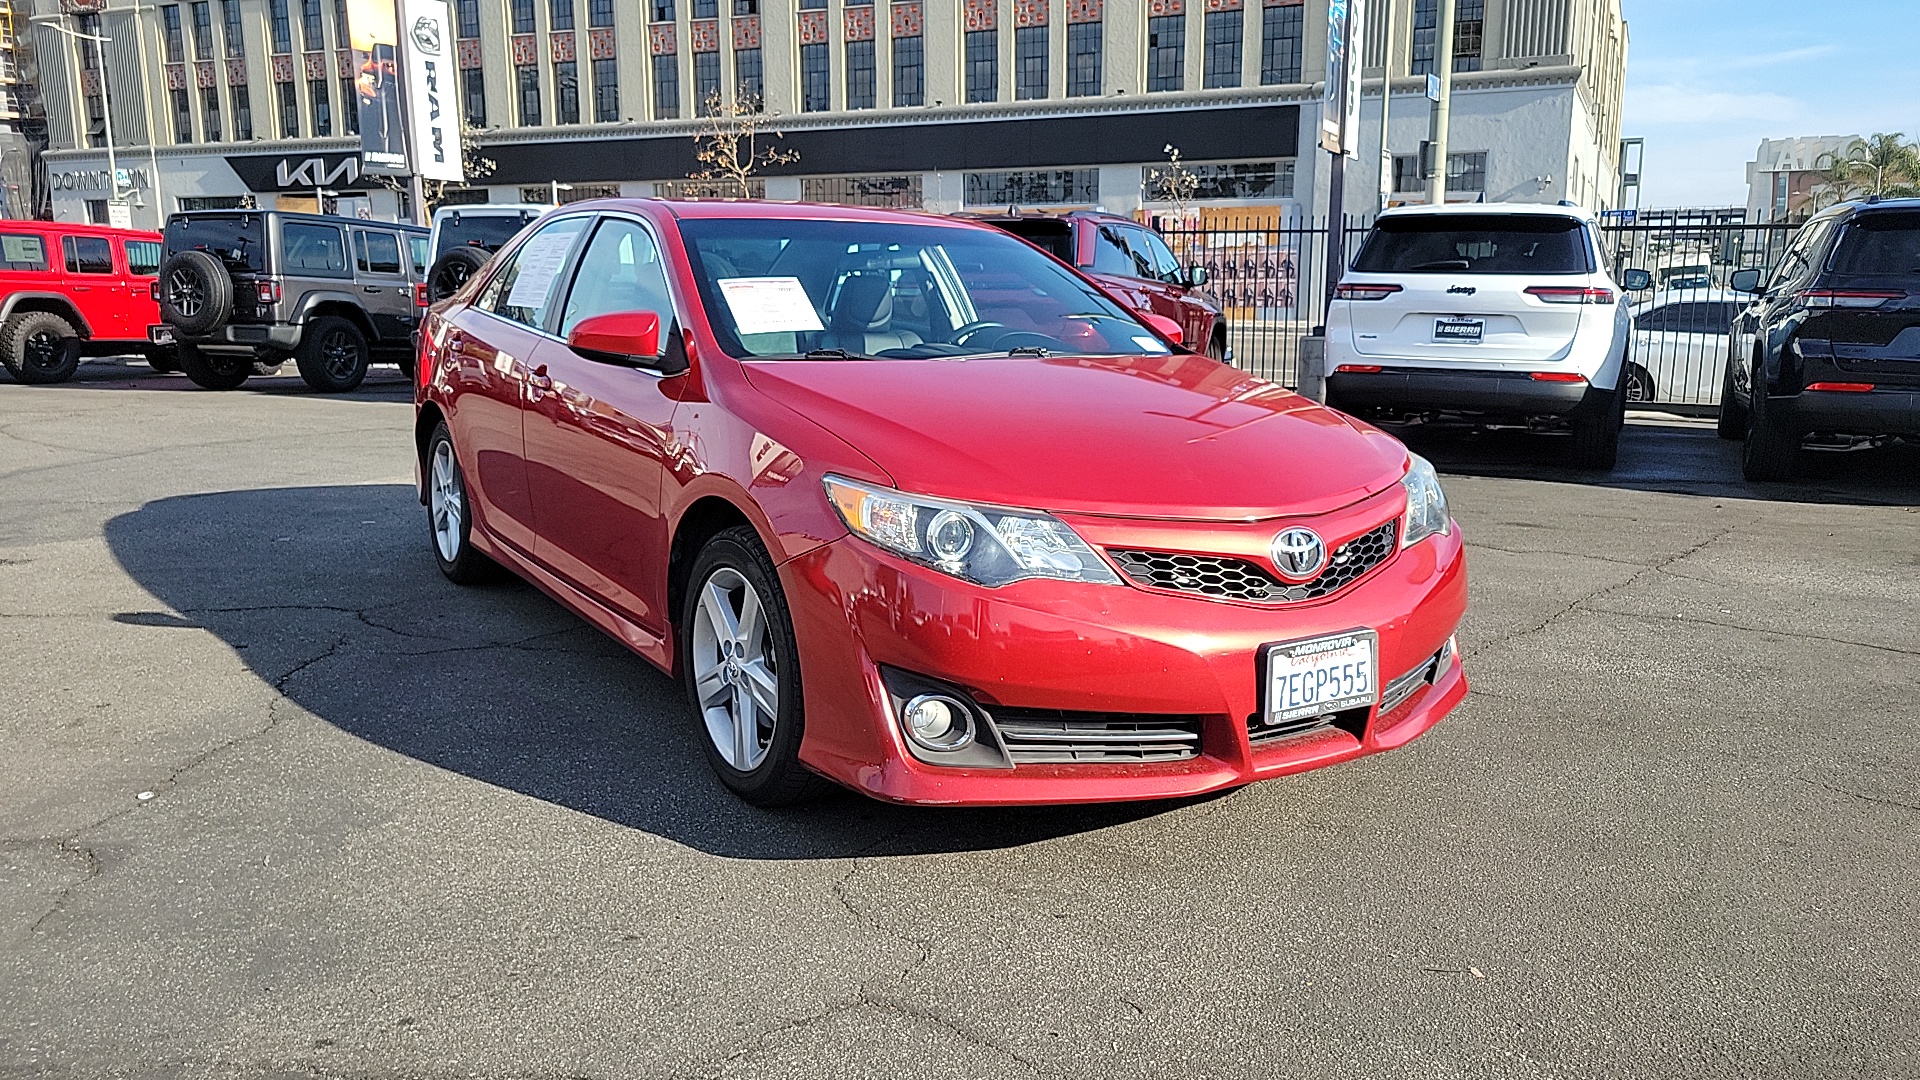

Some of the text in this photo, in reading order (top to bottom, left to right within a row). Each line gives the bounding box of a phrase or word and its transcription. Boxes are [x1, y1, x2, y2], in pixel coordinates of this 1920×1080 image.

[424, 60, 445, 164] RAM
[51, 168, 152, 192] DOWNTWN
[276, 156, 359, 187] KIA
[1446, 284, 1477, 296] Jeep
[1443, 325, 1481, 334] SIERRA
[1294, 636, 1352, 657] MONROVIA
[1275, 661, 1369, 709] 7EGP555
[1281, 696, 1372, 720] SIERRA SUBARU
